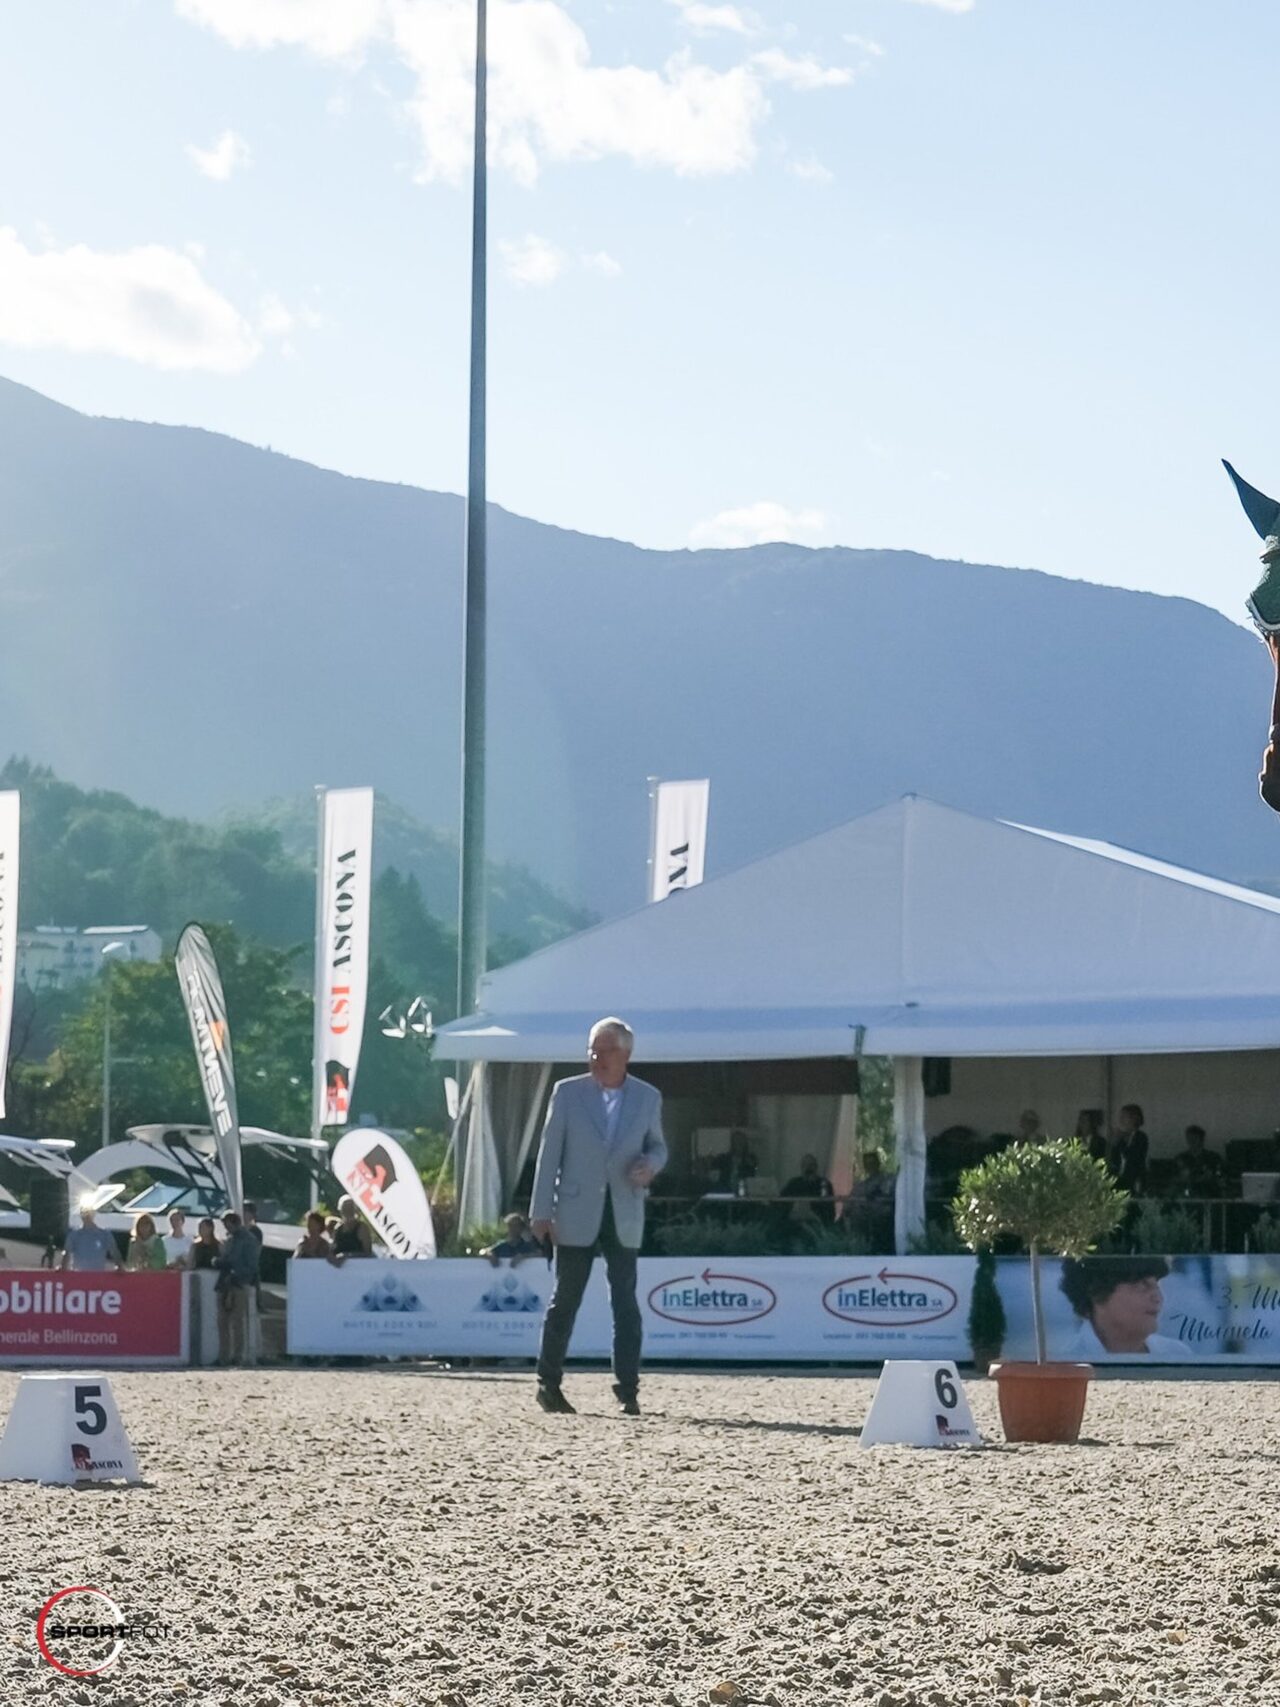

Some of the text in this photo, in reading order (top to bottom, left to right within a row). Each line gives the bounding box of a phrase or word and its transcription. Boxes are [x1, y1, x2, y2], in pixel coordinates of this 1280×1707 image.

[330, 849, 356, 1034] CSI ASCONA
[662, 1287, 748, 1307] inElettra
[837, 1287, 928, 1307] inElettra
[44, 1329, 118, 1345] Bellinzona
[934, 1368, 958, 1409] 6
[75, 1385, 107, 1436] 5
